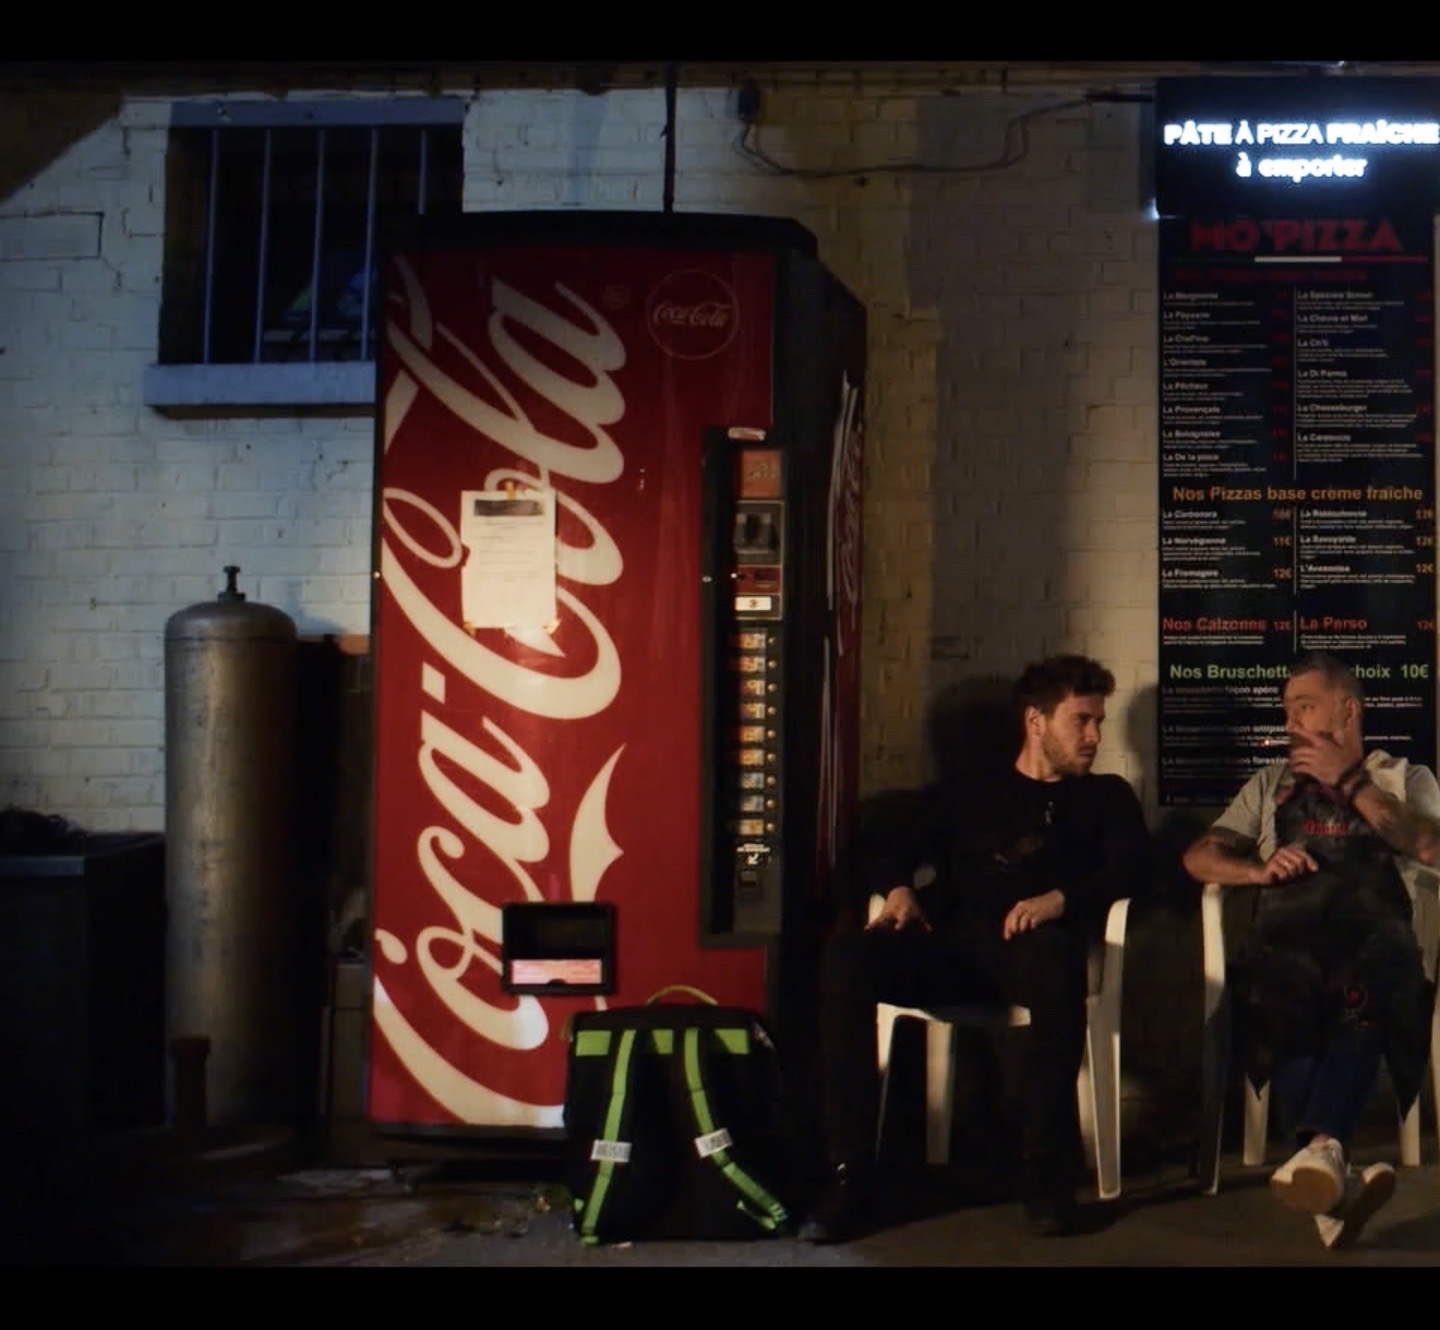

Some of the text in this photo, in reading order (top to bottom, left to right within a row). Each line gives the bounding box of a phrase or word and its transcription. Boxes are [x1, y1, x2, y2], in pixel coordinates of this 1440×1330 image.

[1164, 119, 1440, 145] PÂTE À PIZZA FRAÎCHE
[1235, 152, 1368, 182] à emporter
[1189, 219, 1404, 251] MO'PIZZA
[1173, 486, 1424, 501] Nos Pizzas base crème fraîche
[1163, 617, 1191, 632] Nos
[1197, 617, 1267, 632] Calzones
[1300, 616, 1318, 631] La
[1322, 616, 1368, 631] Perso
[1170, 664, 1291, 680] Nos Bruschett
[1400, 664, 1429, 679] 10€
